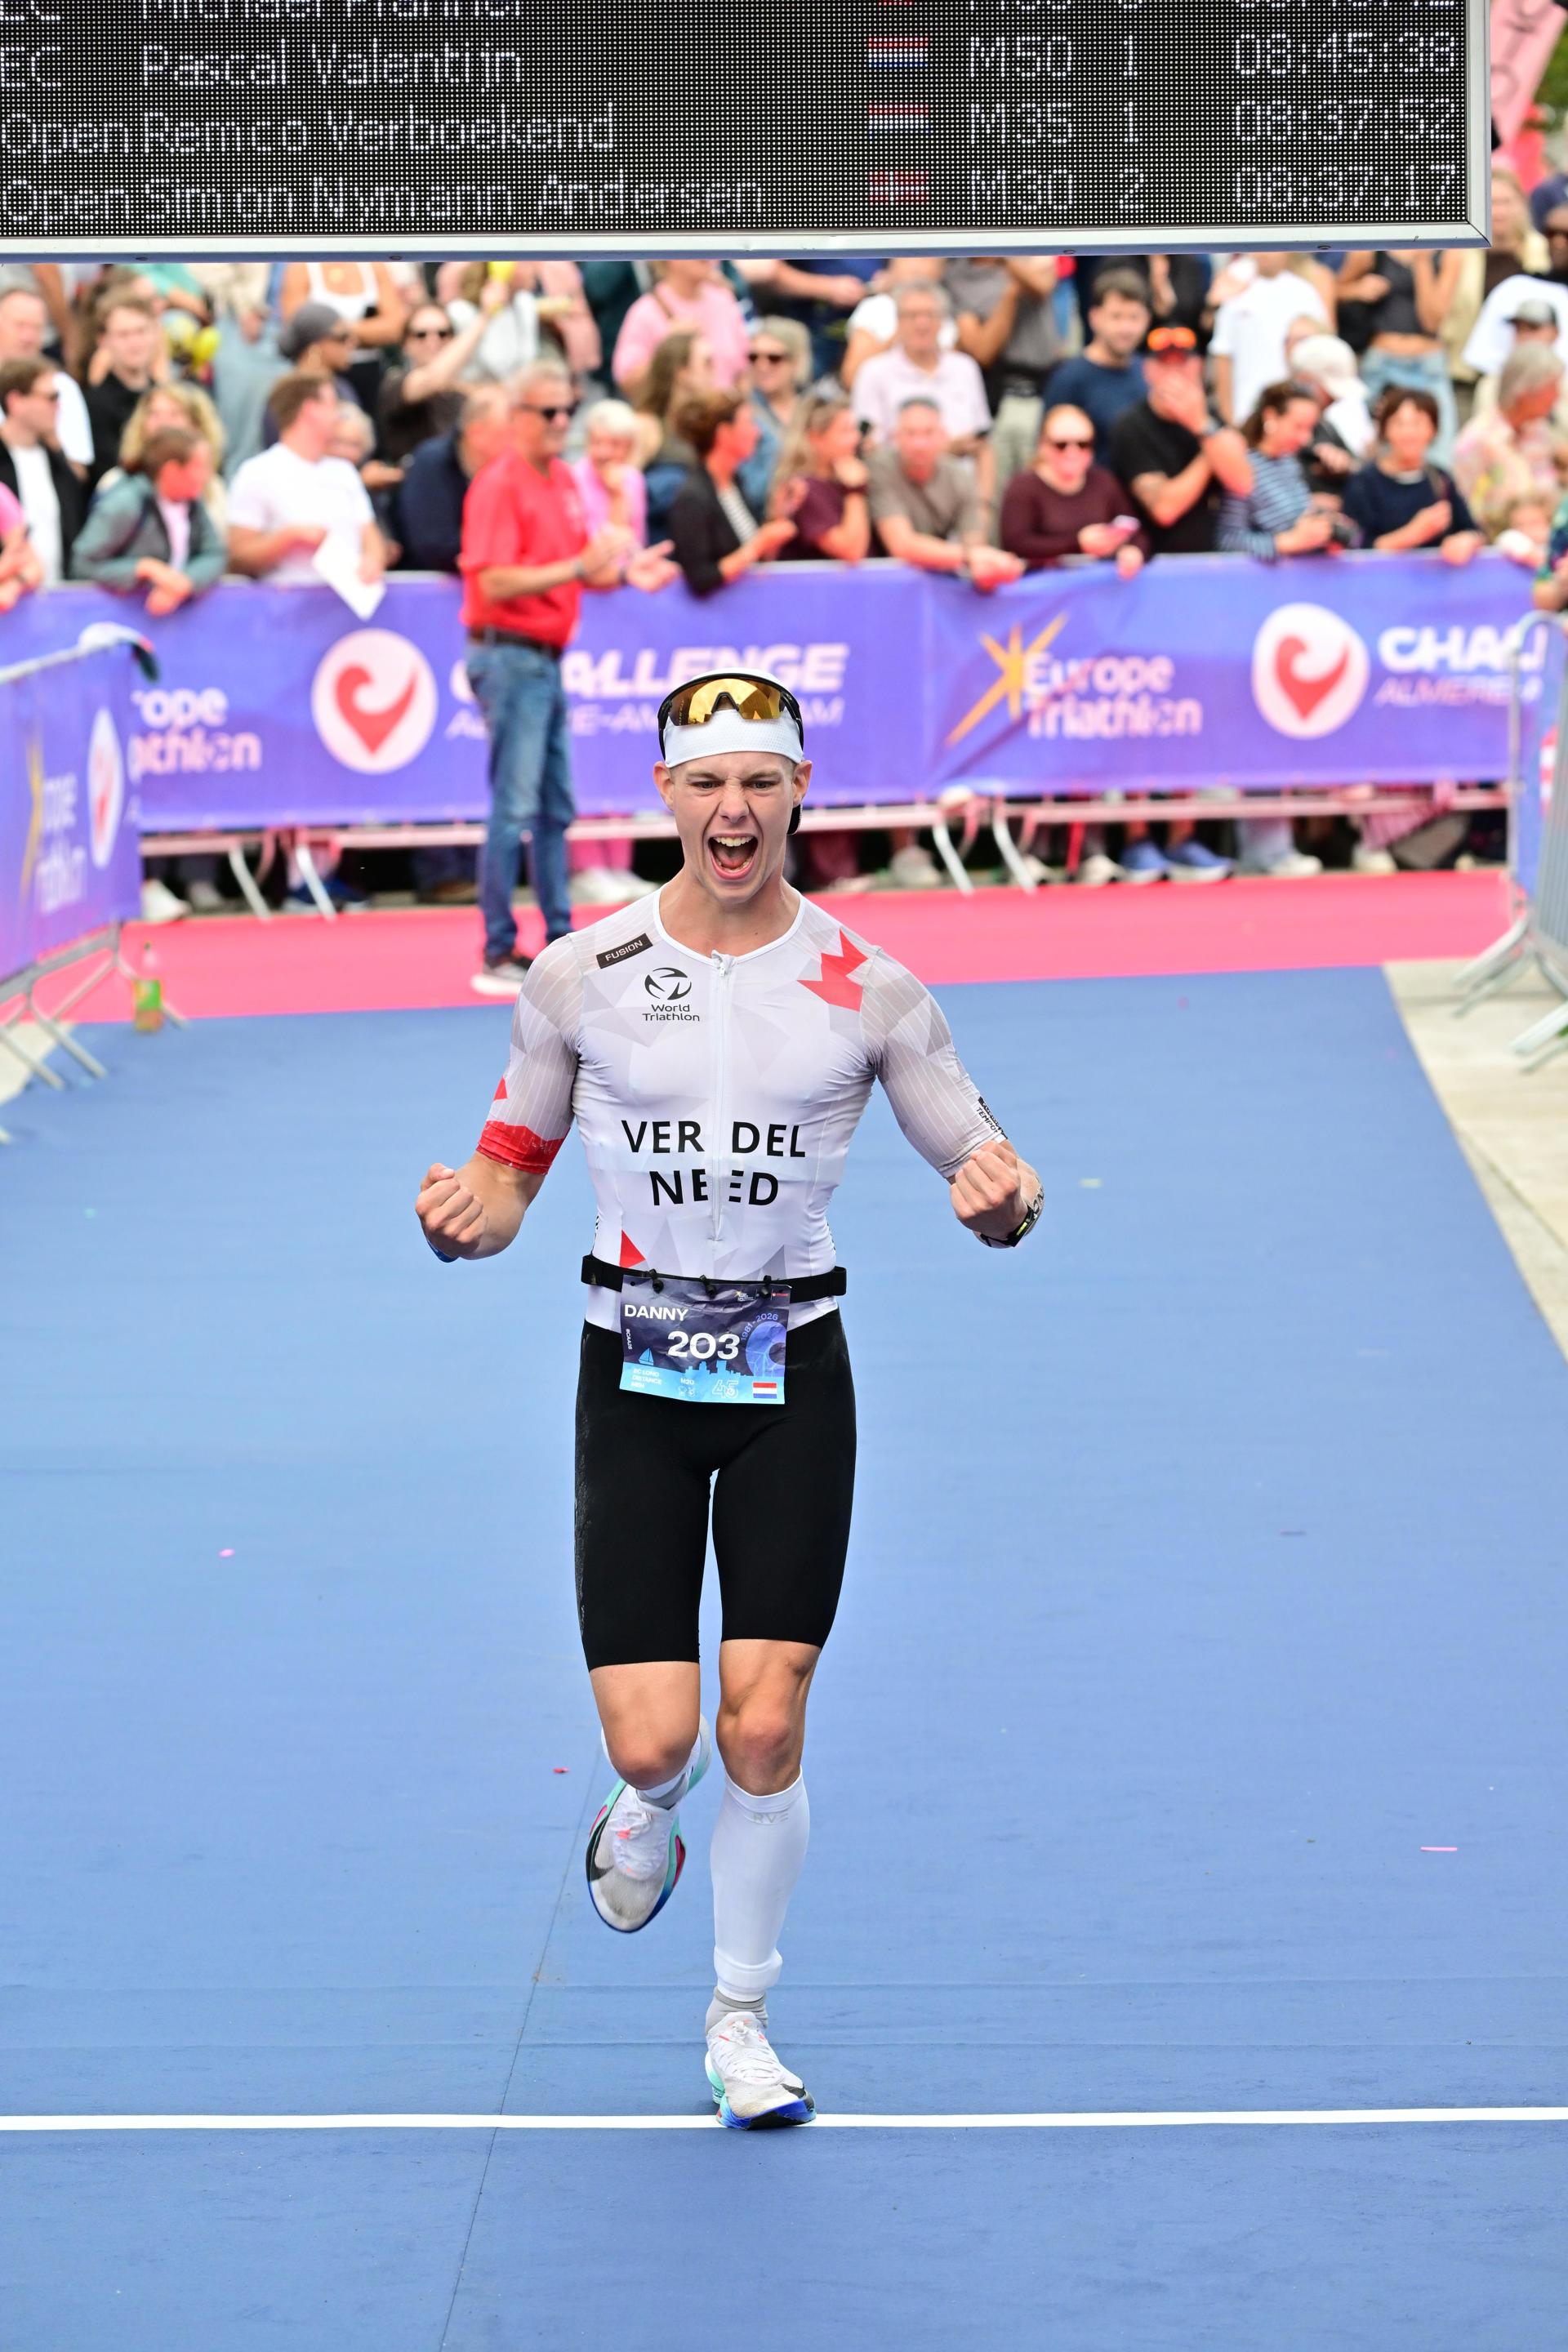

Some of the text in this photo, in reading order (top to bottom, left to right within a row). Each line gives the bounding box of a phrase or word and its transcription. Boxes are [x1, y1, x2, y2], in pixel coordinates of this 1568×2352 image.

[0, 32, 1456, 92] EC Pascal Valentijn M50 1 08:45:38
[1, 99, 1457, 164] Open Remco Verboekend M35 1 08:37:52
[2, 179, 131, 229] Open
[313, 176, 512, 226] Nymann
[537, 167, 763, 216] Andersen
[970, 169, 1074, 212] M30
[1119, 167, 1145, 210] 2
[1234, 165, 1457, 209] 08:37:17
[1024, 653, 1176, 704] Europe
[1026, 693, 1205, 740] Triathlon
[604, 939, 644, 962] FUSION
[642, 1013, 701, 1022] Triathlon
[651, 1004, 690, 1013] World
[621, 1120, 806, 1158] VER DEL
[624, 1304, 689, 1321] DANNY
[667, 1330, 741, 1360] 203
